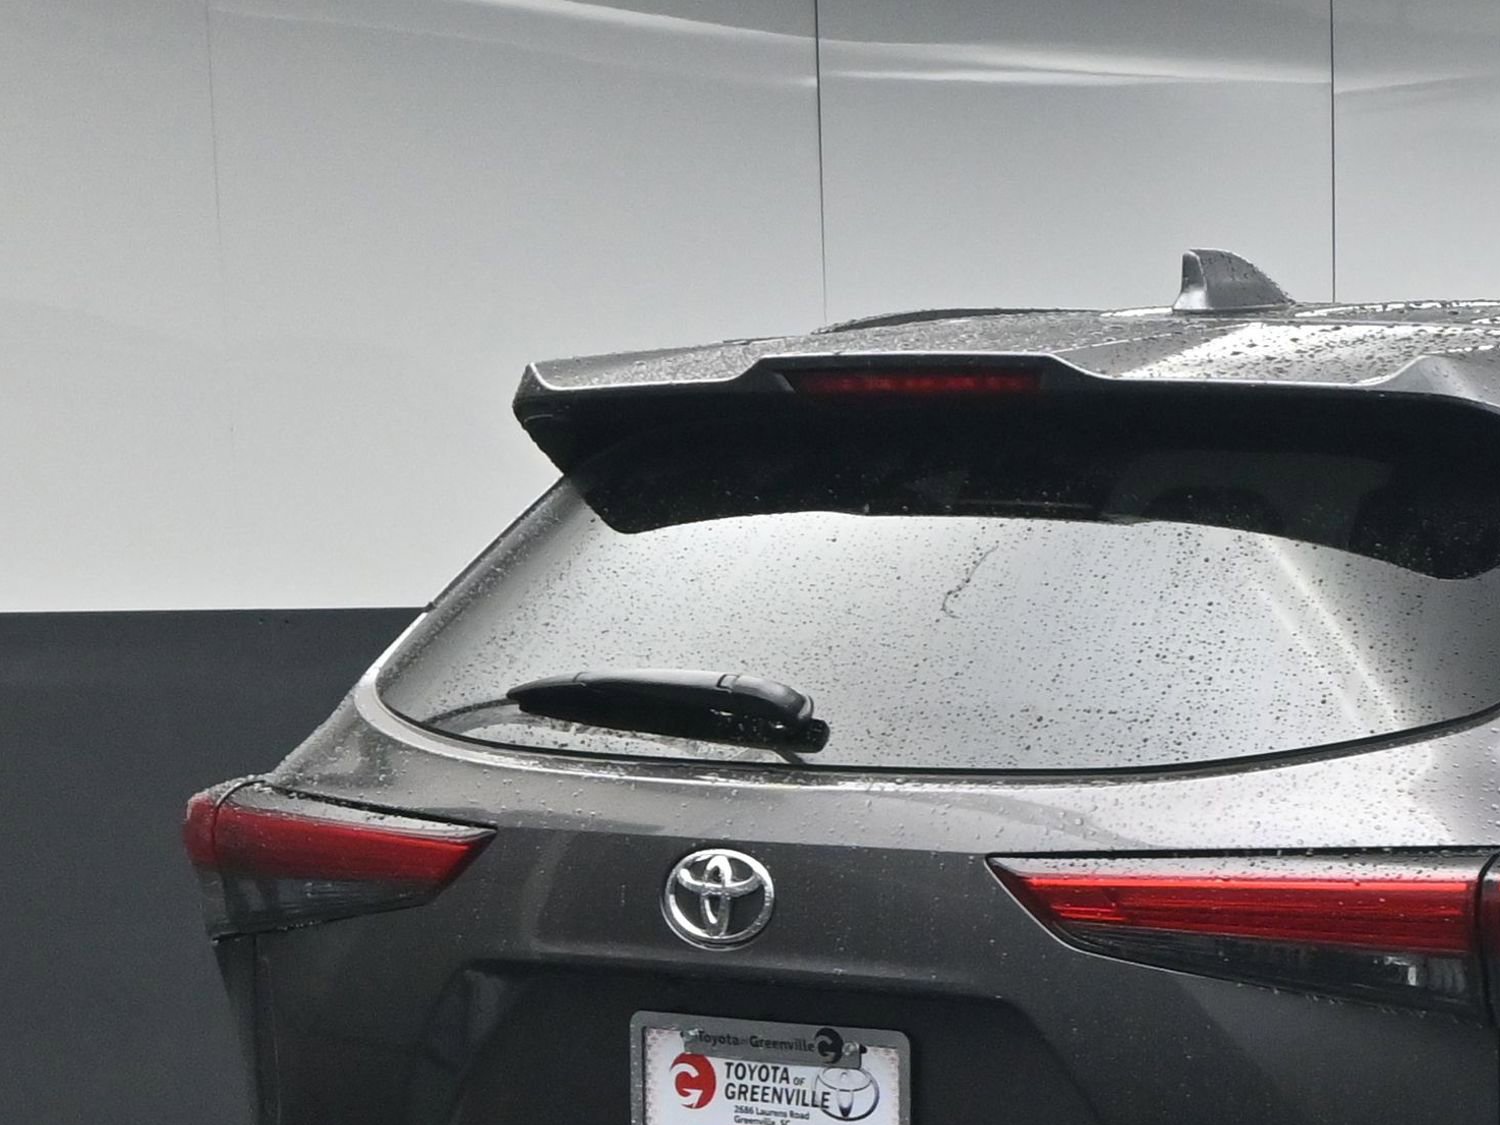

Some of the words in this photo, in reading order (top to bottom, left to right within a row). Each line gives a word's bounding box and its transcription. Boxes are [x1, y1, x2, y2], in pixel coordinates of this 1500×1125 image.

[698, 1030, 739, 1047] Toyota
[750, 1035, 815, 1051] Greenville
[725, 1062, 790, 1085] TOYOTA
[793, 1076, 806, 1086] OF
[725, 1083, 831, 1109] GREENVILLE
[755, 1107, 788, 1118] Laurens
[789, 1110, 810, 1120] Road
